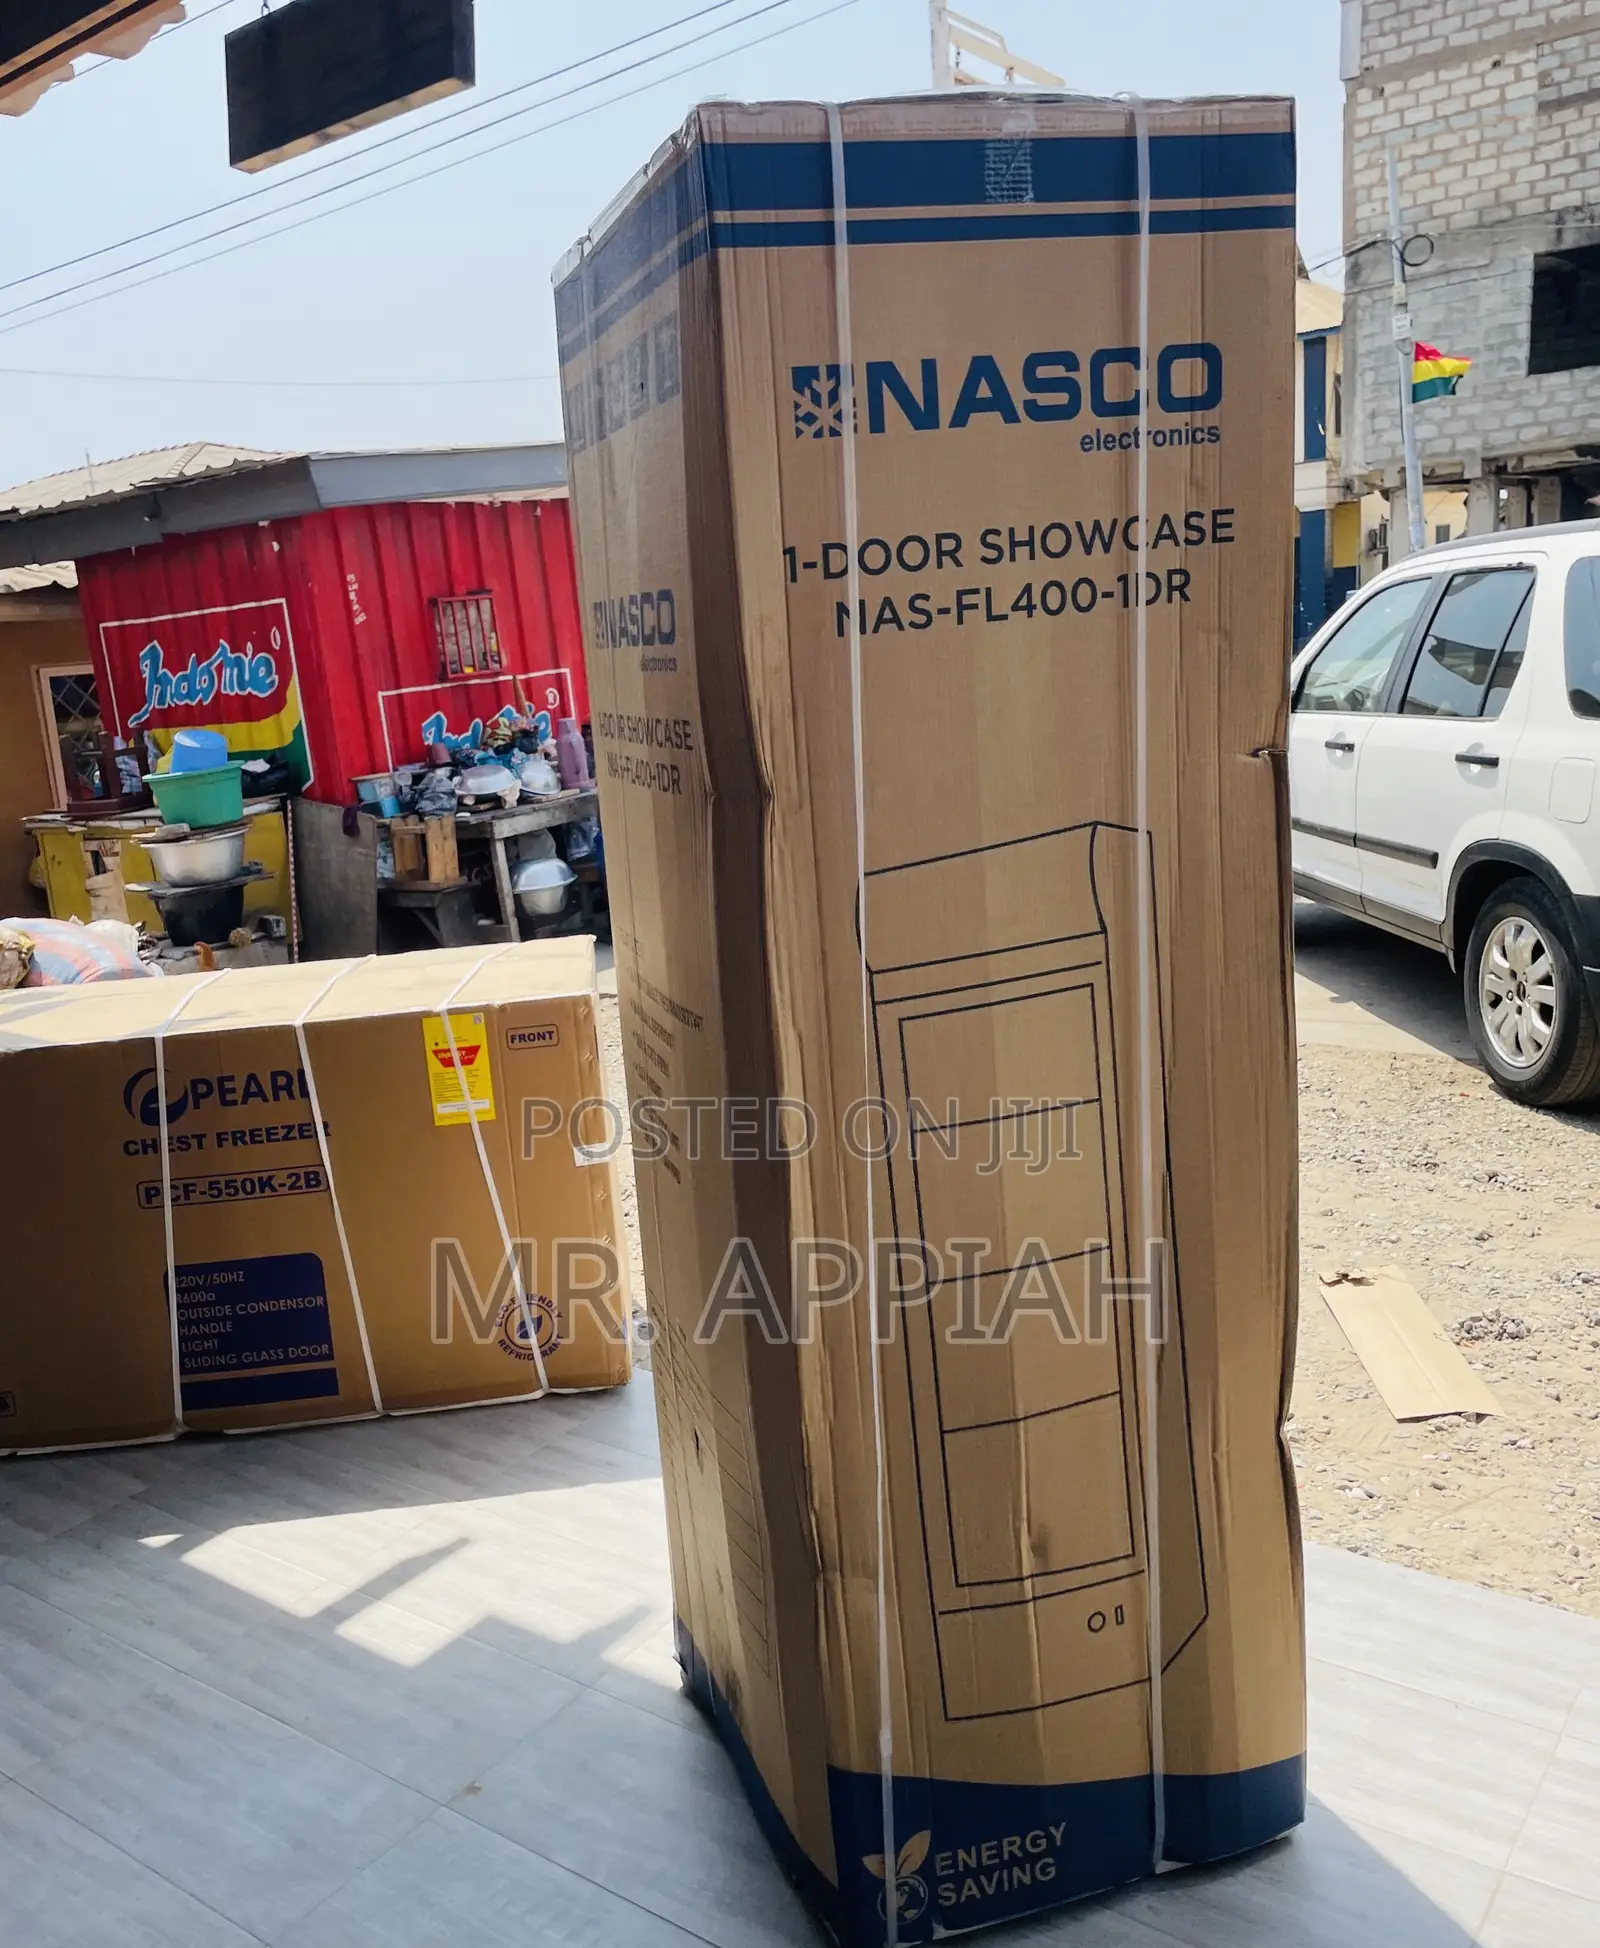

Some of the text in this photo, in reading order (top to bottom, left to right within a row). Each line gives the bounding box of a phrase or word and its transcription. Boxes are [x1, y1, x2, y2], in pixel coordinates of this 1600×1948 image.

[865, 342, 1223, 434] NASCO
[783, 508, 1236, 583] 1-DOOR SHOWCASE
[604, 589, 677, 649] NASCO
[836, 568, 1192, 638] NAS-FL400-1DR
[510, 1030, 555, 1044] FRONT
[190, 1068, 311, 1110] PEARL
[123, 1121, 332, 1157] CHEST FREEZER
[144, 1170, 322, 1205] PCF-550K-2B
[178, 1296, 324, 1321] OUTSIDE CONDENSOR
[180, 1321, 233, 1336] HANDLE
[182, 1339, 219, 1353] LIGHT
[184, 1343, 329, 1369] SLIDING GLASS DOOR
[498, 1333, 564, 1361] REFRIGRANT
[935, 1822, 1067, 1876] ENERGY
[937, 1857, 1057, 1906] SAVING
